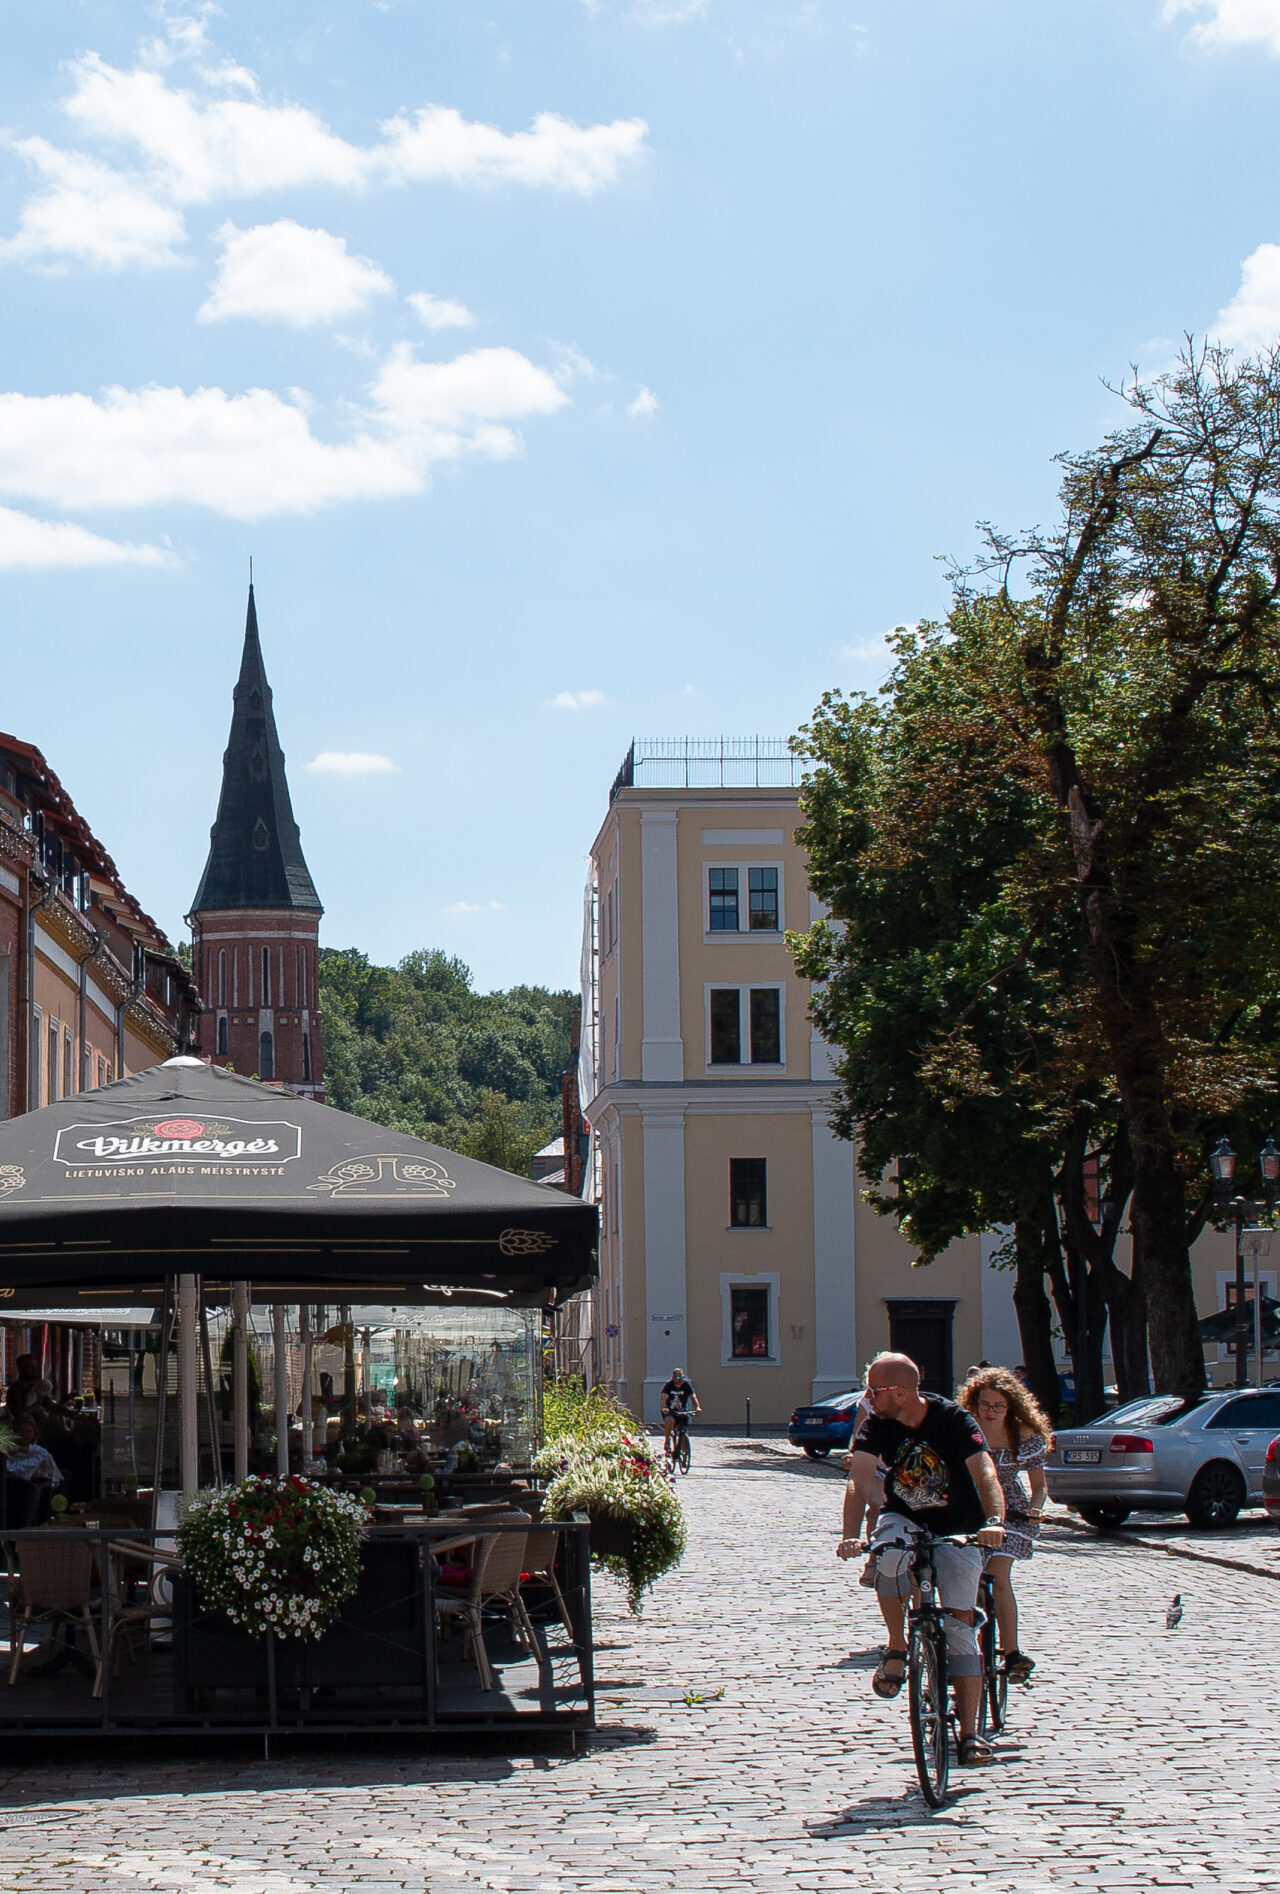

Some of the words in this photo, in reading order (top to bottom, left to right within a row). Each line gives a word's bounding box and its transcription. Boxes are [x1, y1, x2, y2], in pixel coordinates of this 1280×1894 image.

[76, 1136, 280, 1159] Vilkmergės
[151, 1166, 195, 1176] ALAUS
[200, 1166, 286, 1176] MEISTRYSTĖ
